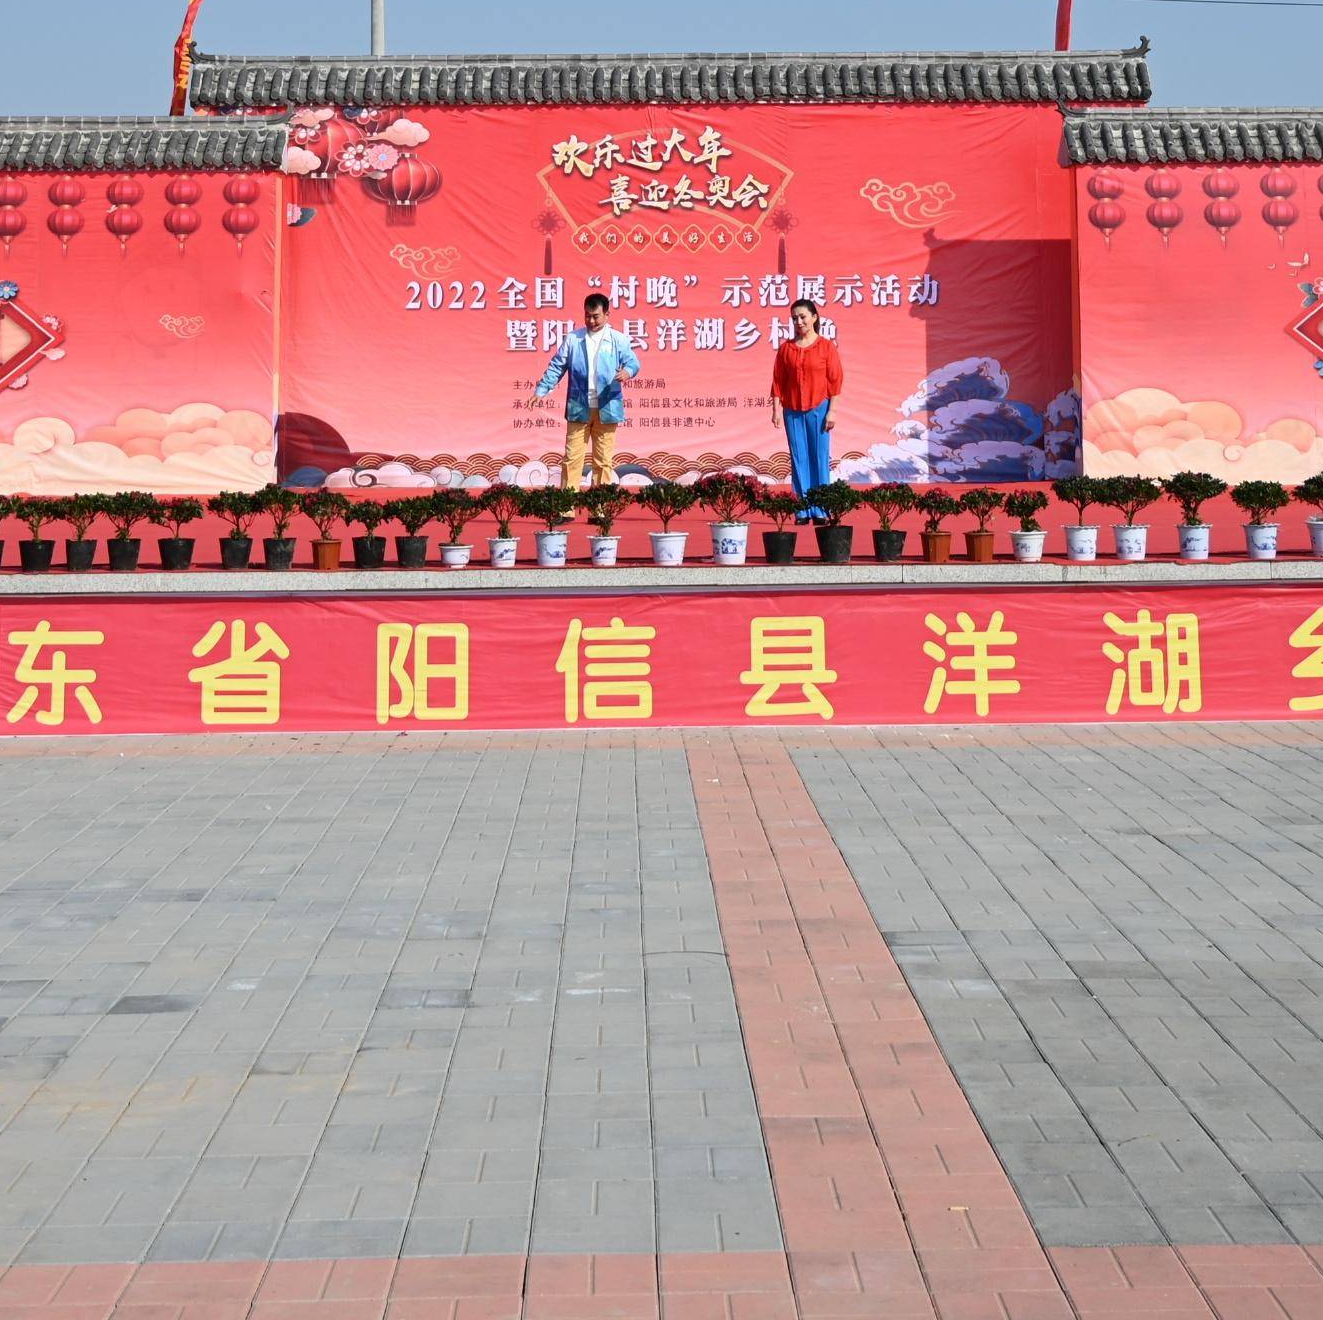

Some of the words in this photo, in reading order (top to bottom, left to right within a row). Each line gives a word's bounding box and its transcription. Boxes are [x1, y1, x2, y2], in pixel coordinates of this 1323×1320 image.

[552, 125, 732, 177] 欢乐过大年
[598, 173, 771, 216] 喜迎冬奥会
[578, 231, 753, 245] 我们的美好生活
[506, 316, 838, 353] 暨阳县洋湖乡村
[639, 417, 716, 428] 阳信县非遗中心
